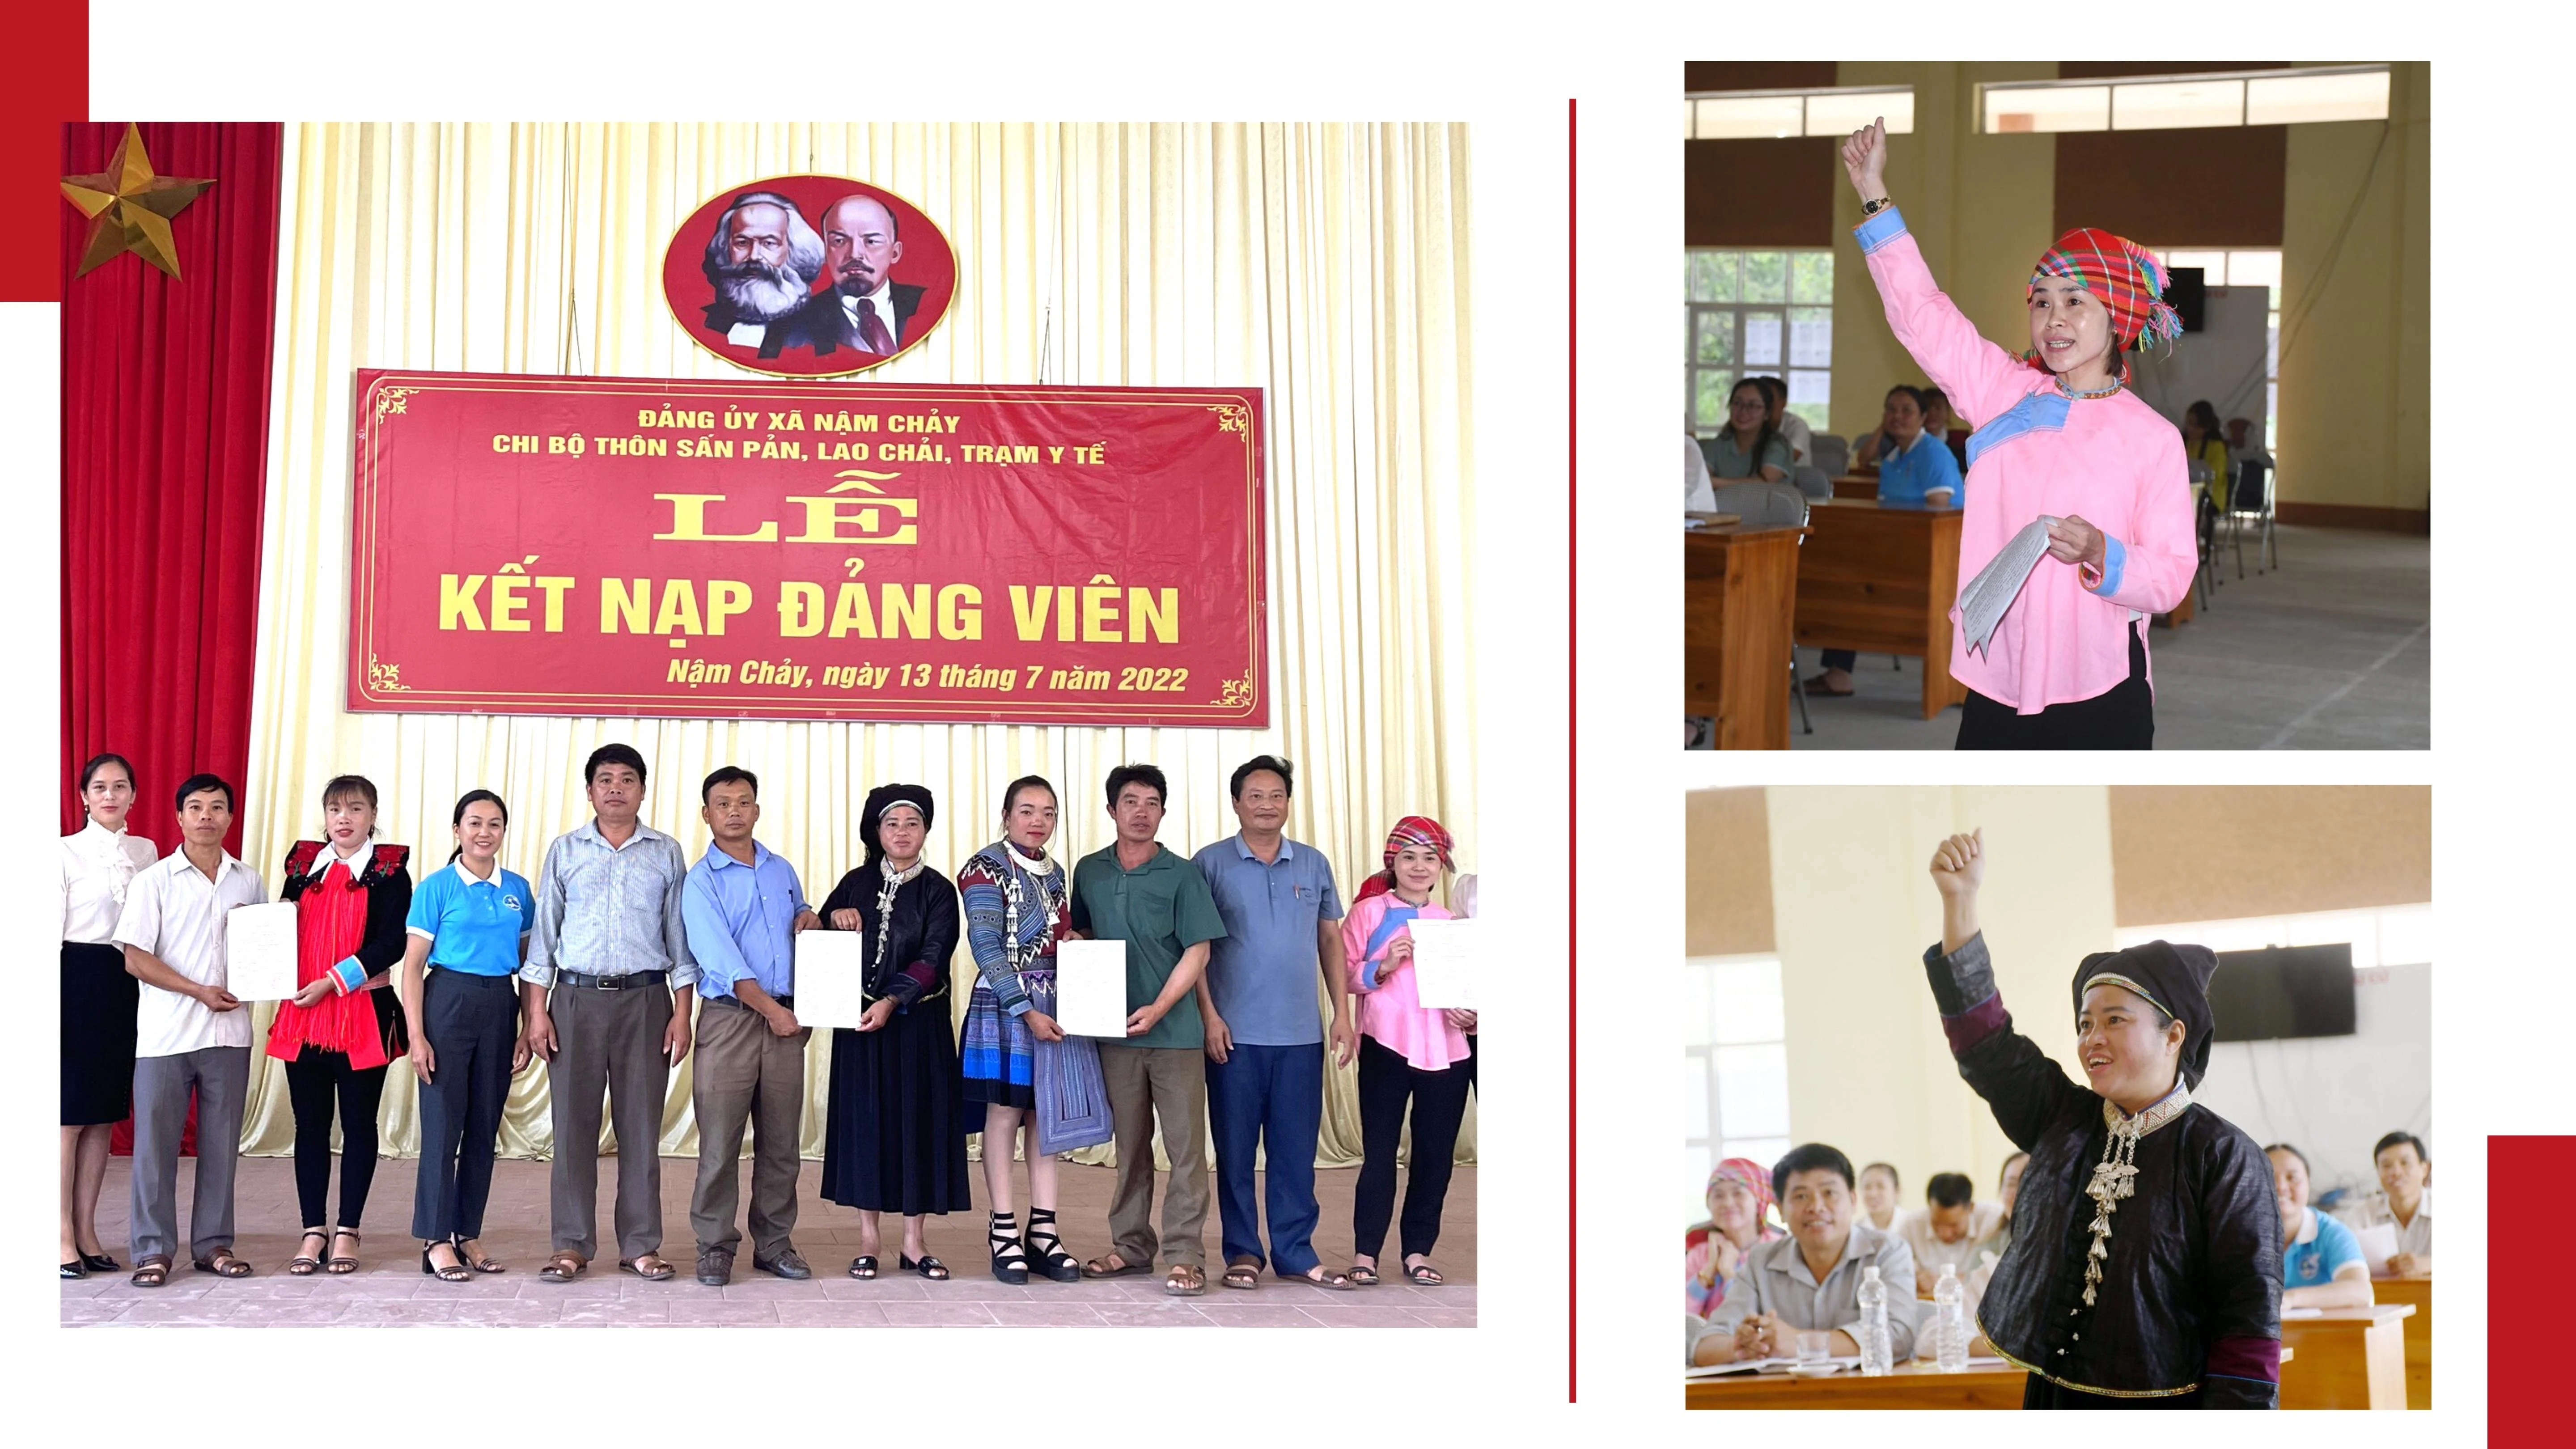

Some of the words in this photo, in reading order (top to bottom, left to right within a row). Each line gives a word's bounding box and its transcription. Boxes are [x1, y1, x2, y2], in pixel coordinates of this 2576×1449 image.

[637, 402, 715, 430] ĐẢNG
[724, 404, 759, 430] ỦY
[767, 411, 805, 432] XÃ
[814, 410, 878, 436] NẬM
[888, 408, 960, 434] CHẢY
[492, 434, 539, 453] CHI
[548, 433, 585, 459] BỘ
[593, 434, 667, 457] THÔN
[676, 433, 733, 458] SẤN
[742, 433, 808, 462] PẢN,
[818, 442, 869, 461] LAO
[878, 436, 952, 464] CHẢI,
[960, 445, 1039, 467] TRẠM
[1048, 446, 1065, 464] Y
[1073, 441, 1107, 465] TẾ
[652, 469, 918, 545] LỄ
[439, 554, 576, 632] KẾT
[600, 577, 753, 649] NẠP
[777, 557, 982, 641] ĐẢNG
[1008, 574, 1179, 644] VIÊN
[666, 658, 732, 689] Nậm
[739, 657, 813, 689] Chảy,
[822, 661, 891, 690] ngày
[900, 663, 932, 687] 13
[939, 663, 1017, 692] tháng
[1025, 665, 1044, 689] 7
[1049, 665, 1111, 690] năm
[1117, 667, 1189, 691] 2022
